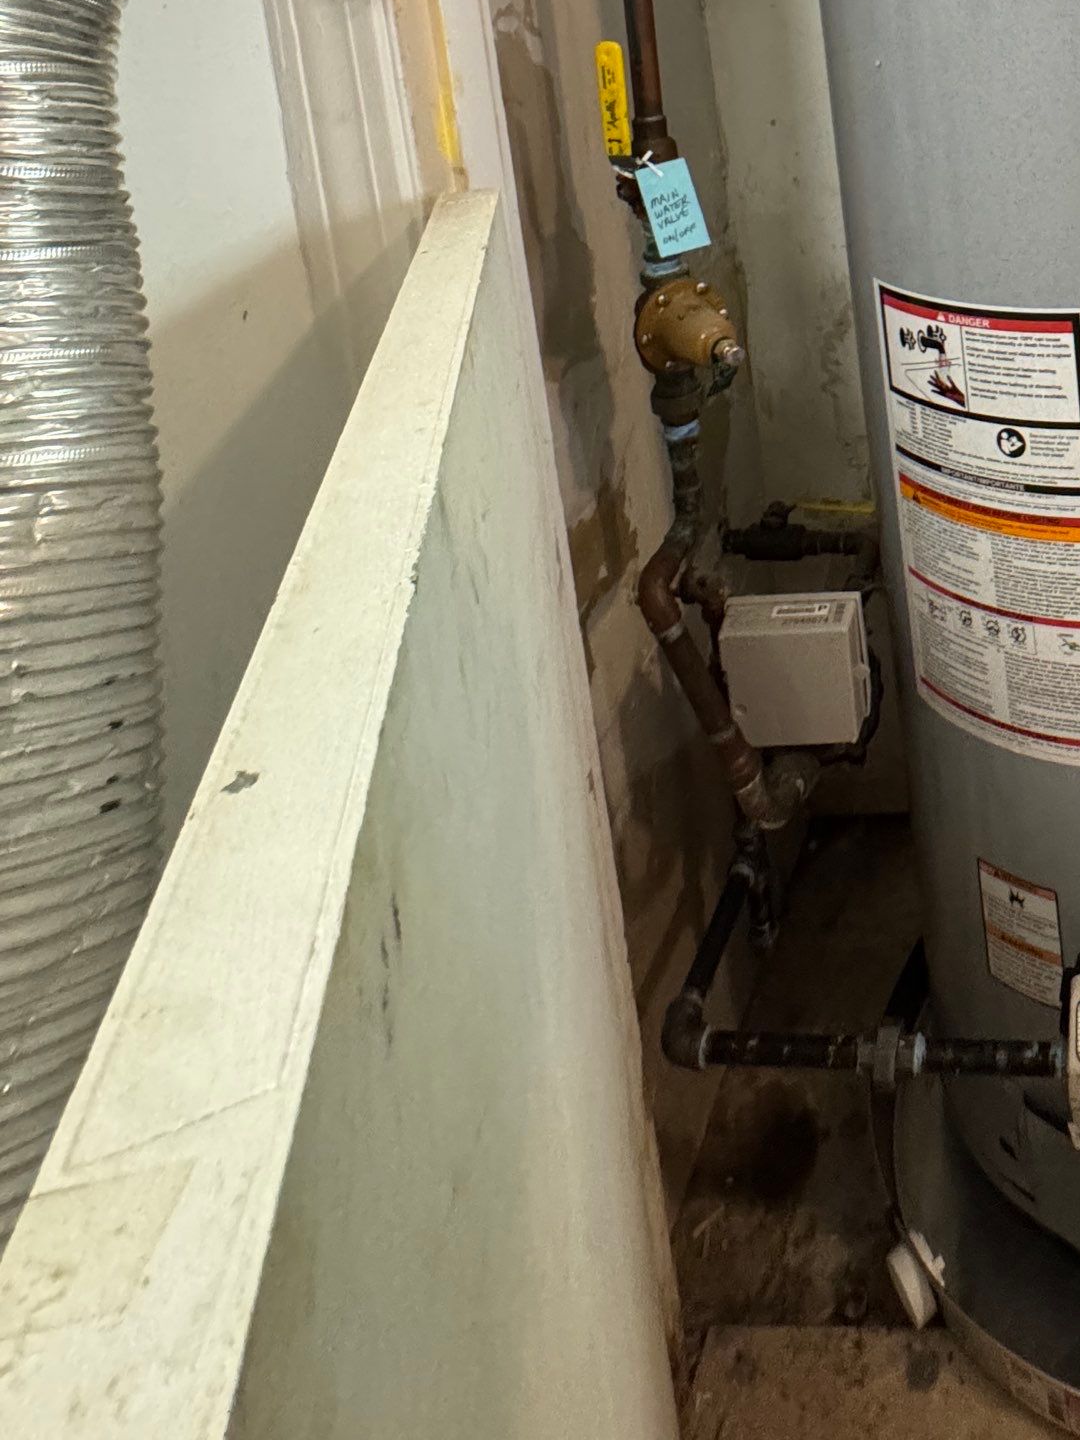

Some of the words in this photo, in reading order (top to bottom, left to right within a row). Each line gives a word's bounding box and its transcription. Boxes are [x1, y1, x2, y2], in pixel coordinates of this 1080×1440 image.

[650, 188, 680, 210] MAIN
[654, 195, 691, 220] WATER
[657, 208, 691, 231] VALVE
[948, 314, 991, 329] DANGER
